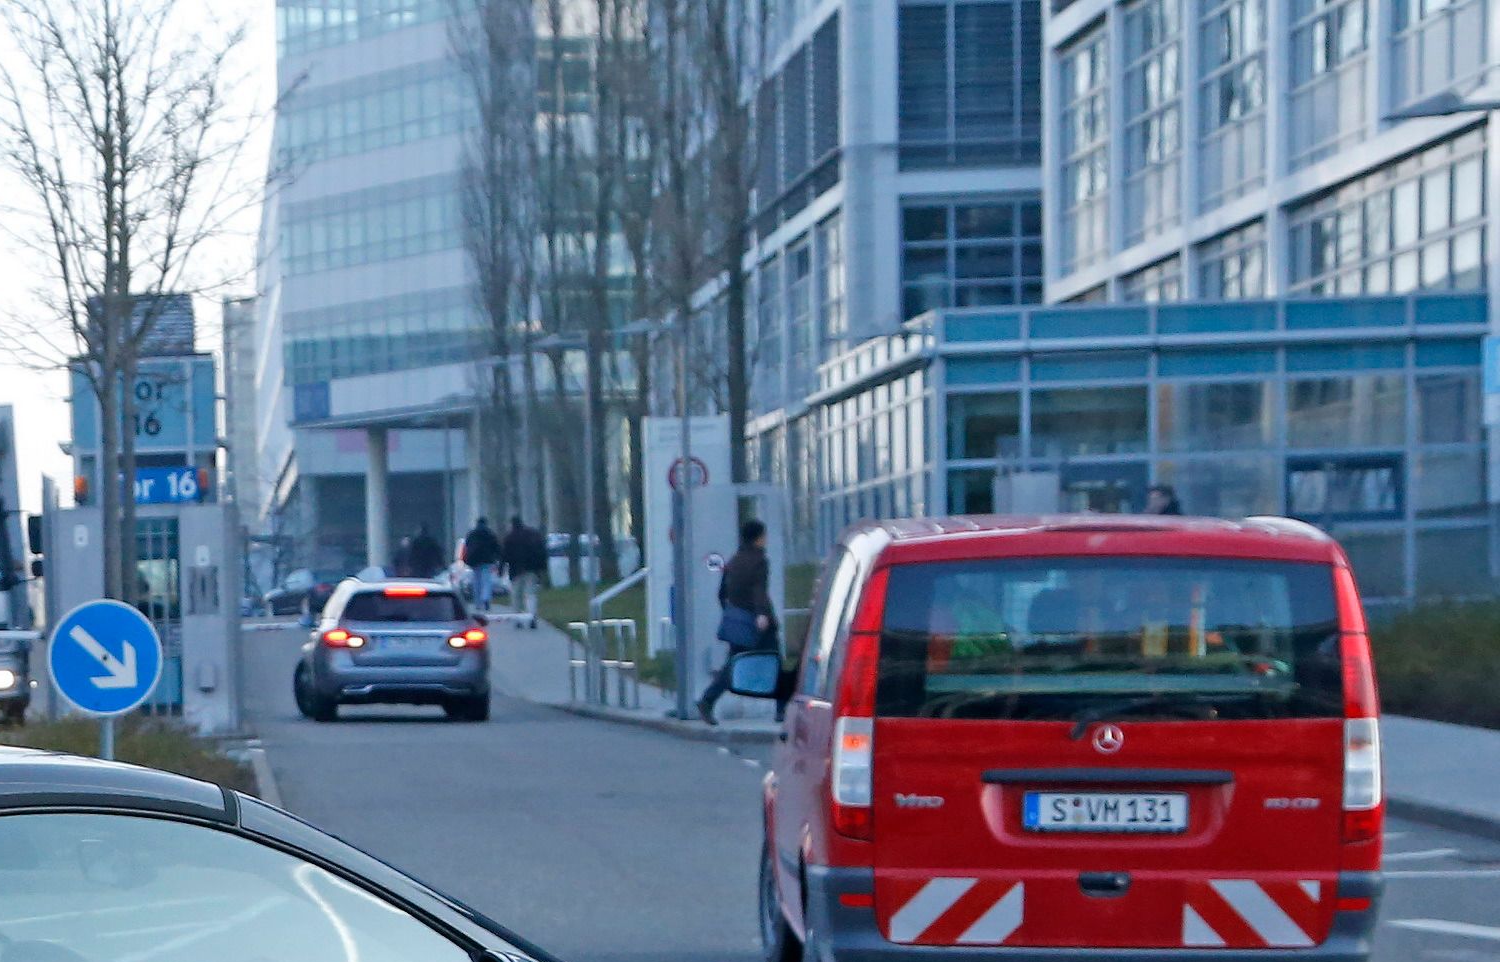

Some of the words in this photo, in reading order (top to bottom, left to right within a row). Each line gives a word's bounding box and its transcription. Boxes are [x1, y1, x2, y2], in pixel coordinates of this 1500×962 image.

[133, 411, 162, 435] 16
[167, 471, 198, 498] 16
[1051, 797, 1068, 823] S
[1086, 797, 1120, 823] VM
[1126, 798, 1173, 823] 131
